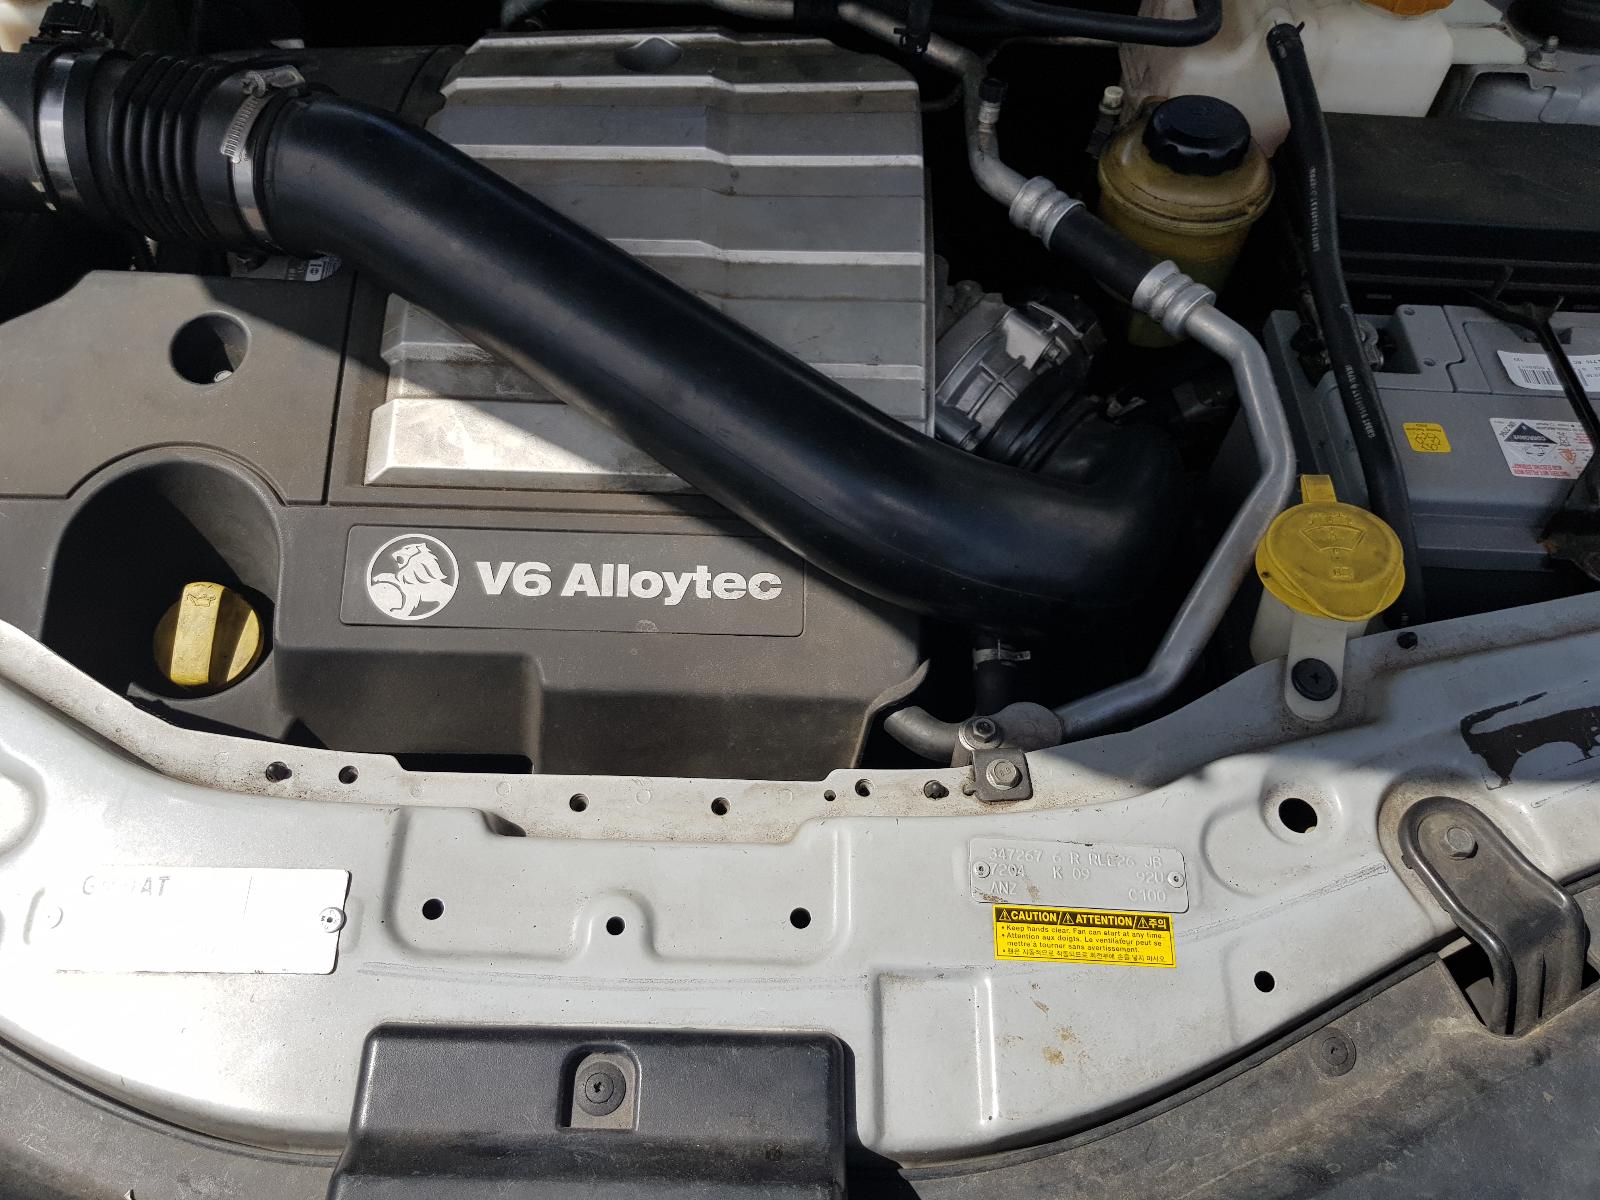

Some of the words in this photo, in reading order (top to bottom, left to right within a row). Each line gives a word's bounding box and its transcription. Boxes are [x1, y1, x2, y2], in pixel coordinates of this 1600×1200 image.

[475, 561, 552, 596] V6
[560, 563, 783, 606] Alloytec
[1070, 852, 1080, 865] R
[1053, 866, 1063, 880] K
[1072, 867, 1090, 880] 09
[990, 881, 1018, 895] ANZ
[1148, 918, 1167, 930] 주의
[1096, 937, 1133, 945] ventilateur
